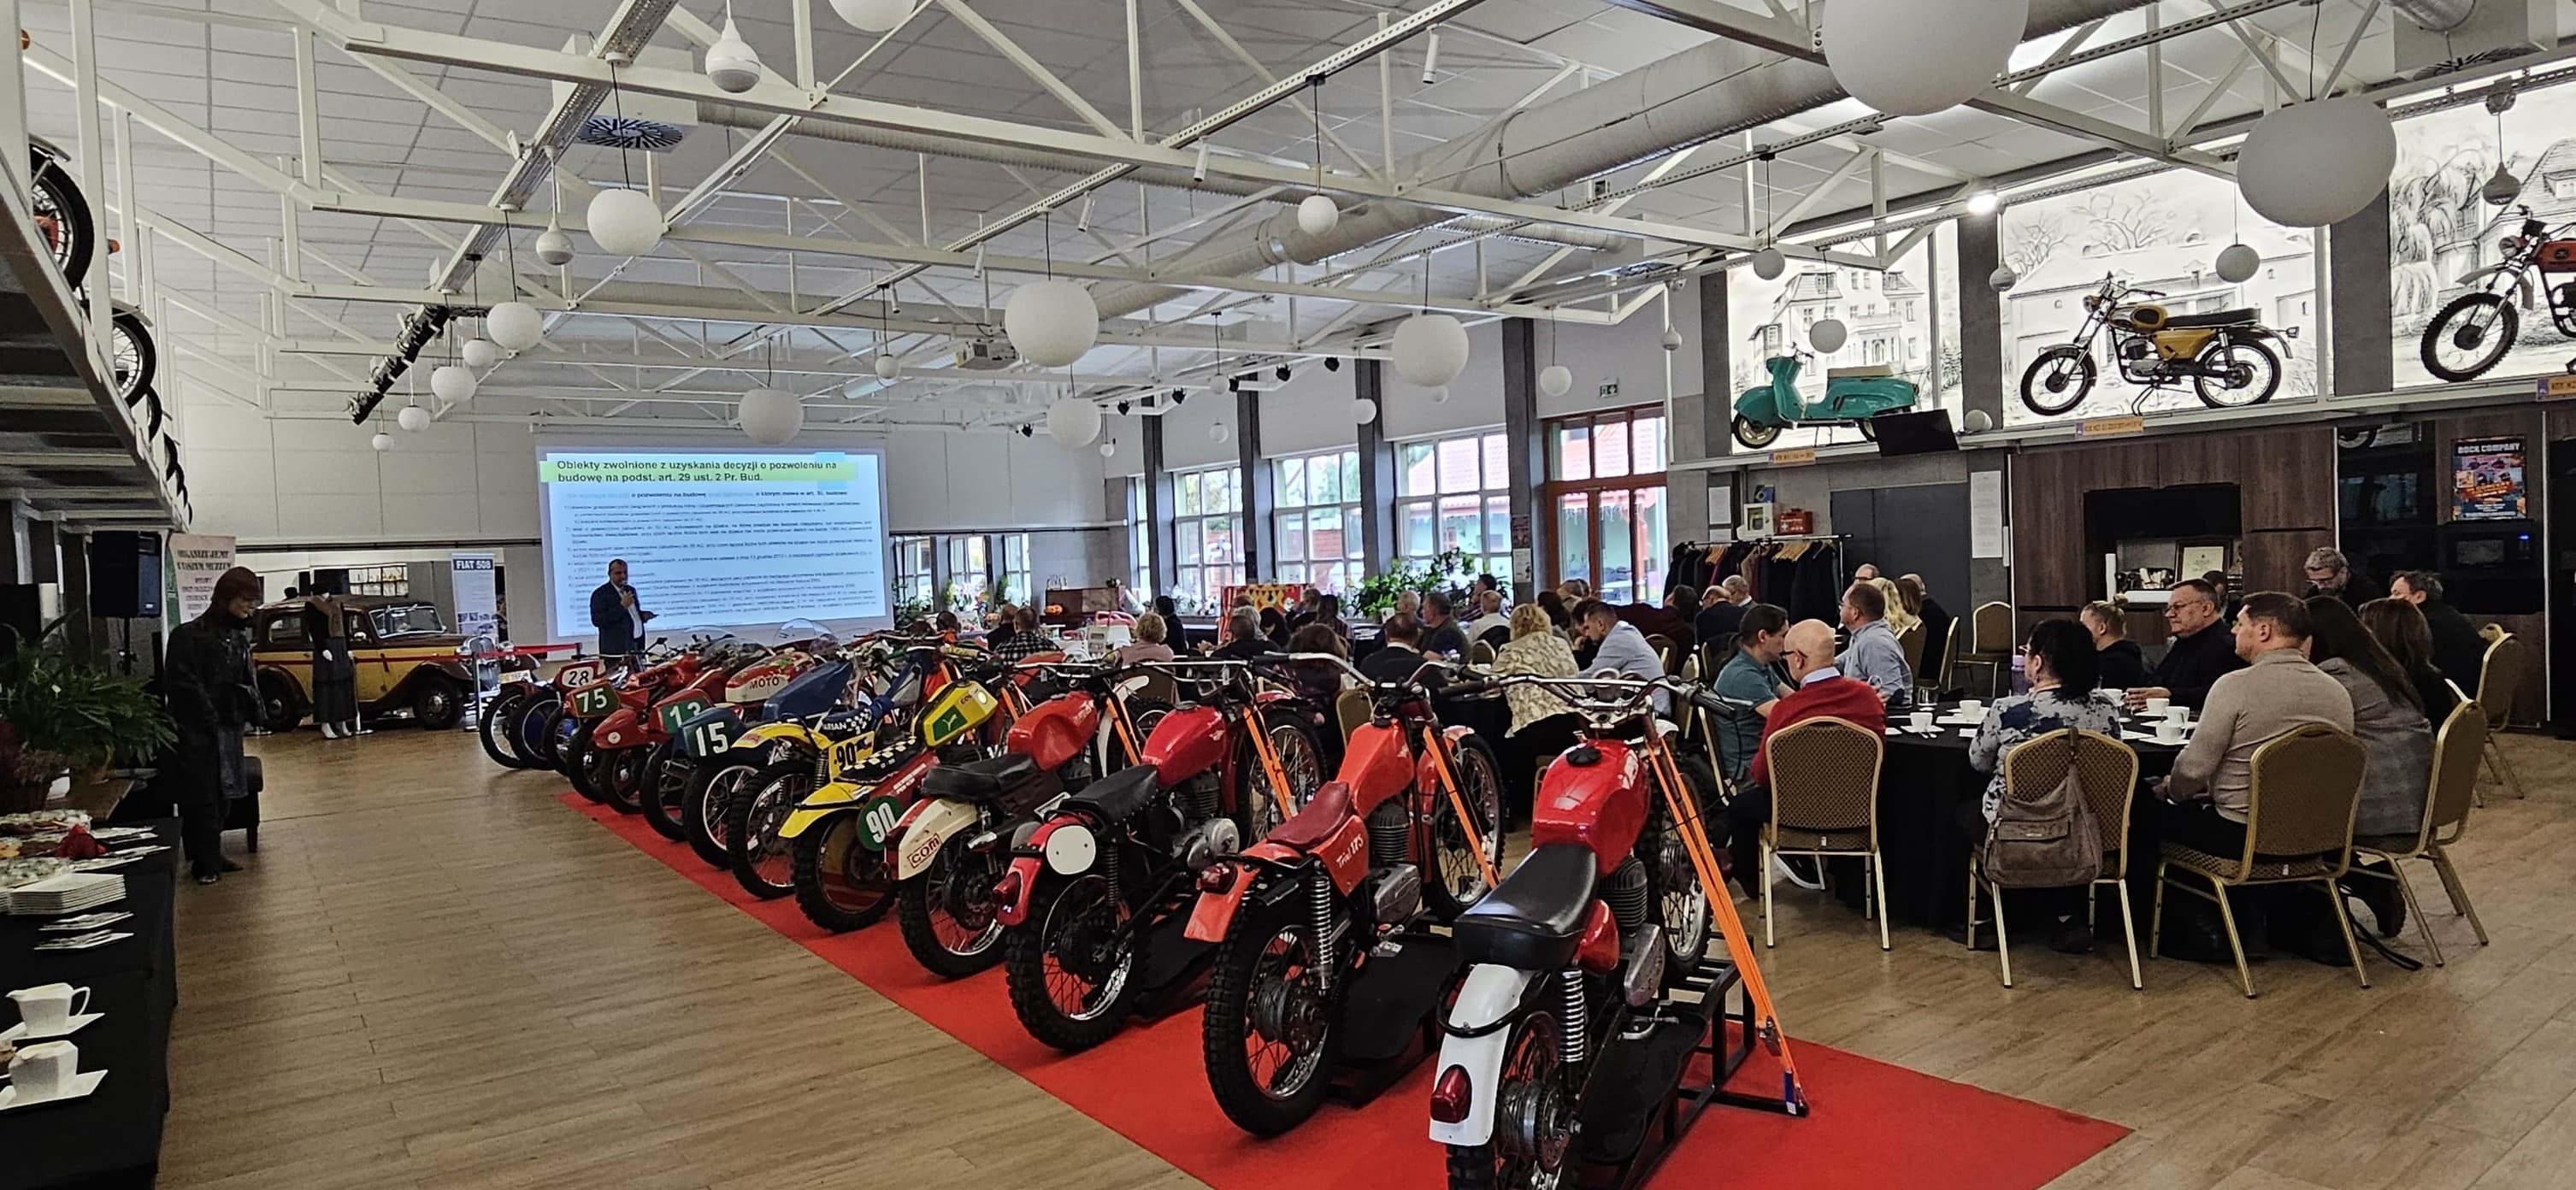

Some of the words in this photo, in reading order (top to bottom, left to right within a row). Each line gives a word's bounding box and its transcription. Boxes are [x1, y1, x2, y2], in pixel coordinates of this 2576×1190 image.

[2458, 445, 2479, 454] ROCK
[2481, 443, 2520, 452] COMPANY
[557, 461, 599, 471] Obiekty
[604, 461, 657, 469] zwolnione
[669, 461, 721, 471] uzyskania
[723, 462, 758, 471] decyzji
[769, 462, 822, 471] pozwoleniu
[558, 474, 602, 483] budowę
[622, 474, 656, 483] podst.
[740, 473, 763, 481] Bud.
[456, 560, 475, 569] FIAT
[569, 670, 589, 686] 28
[750, 676, 780, 690] MOTO
[575, 688, 608, 713] 75
[695, 722, 728, 757] 15
[866, 803, 897, 843] 90
